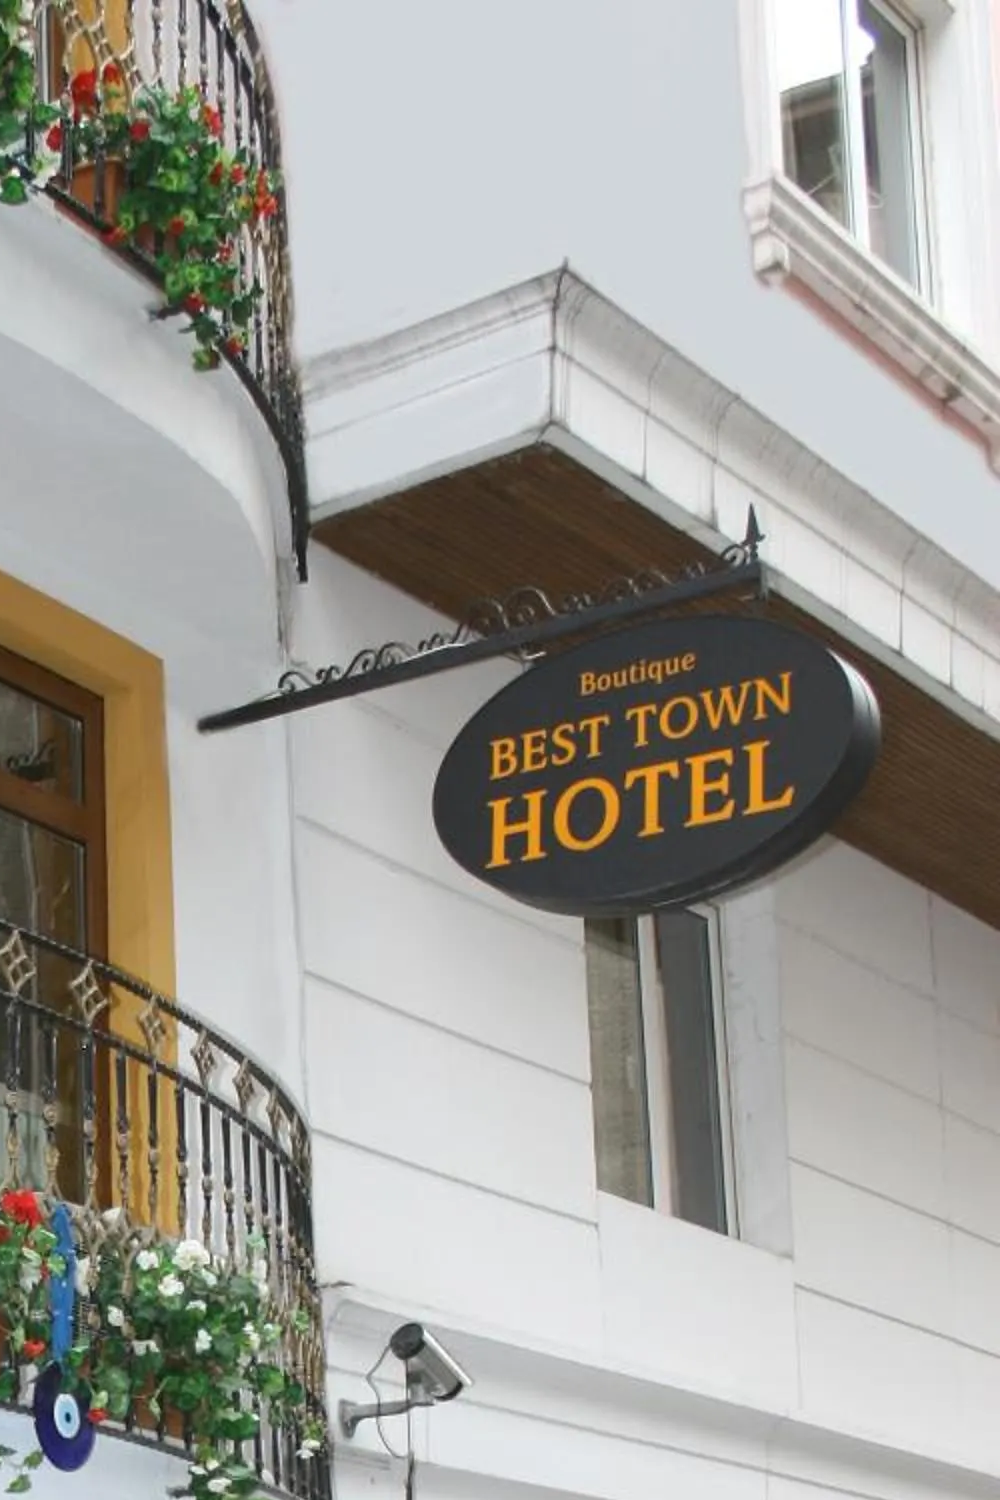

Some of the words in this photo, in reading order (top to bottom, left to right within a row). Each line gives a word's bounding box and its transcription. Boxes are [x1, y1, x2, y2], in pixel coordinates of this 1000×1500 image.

[489, 715, 610, 779] BEST
[626, 672, 793, 747] TOWN
[580, 653, 696, 696] Boutique
[486, 740, 795, 868] HOTEL
